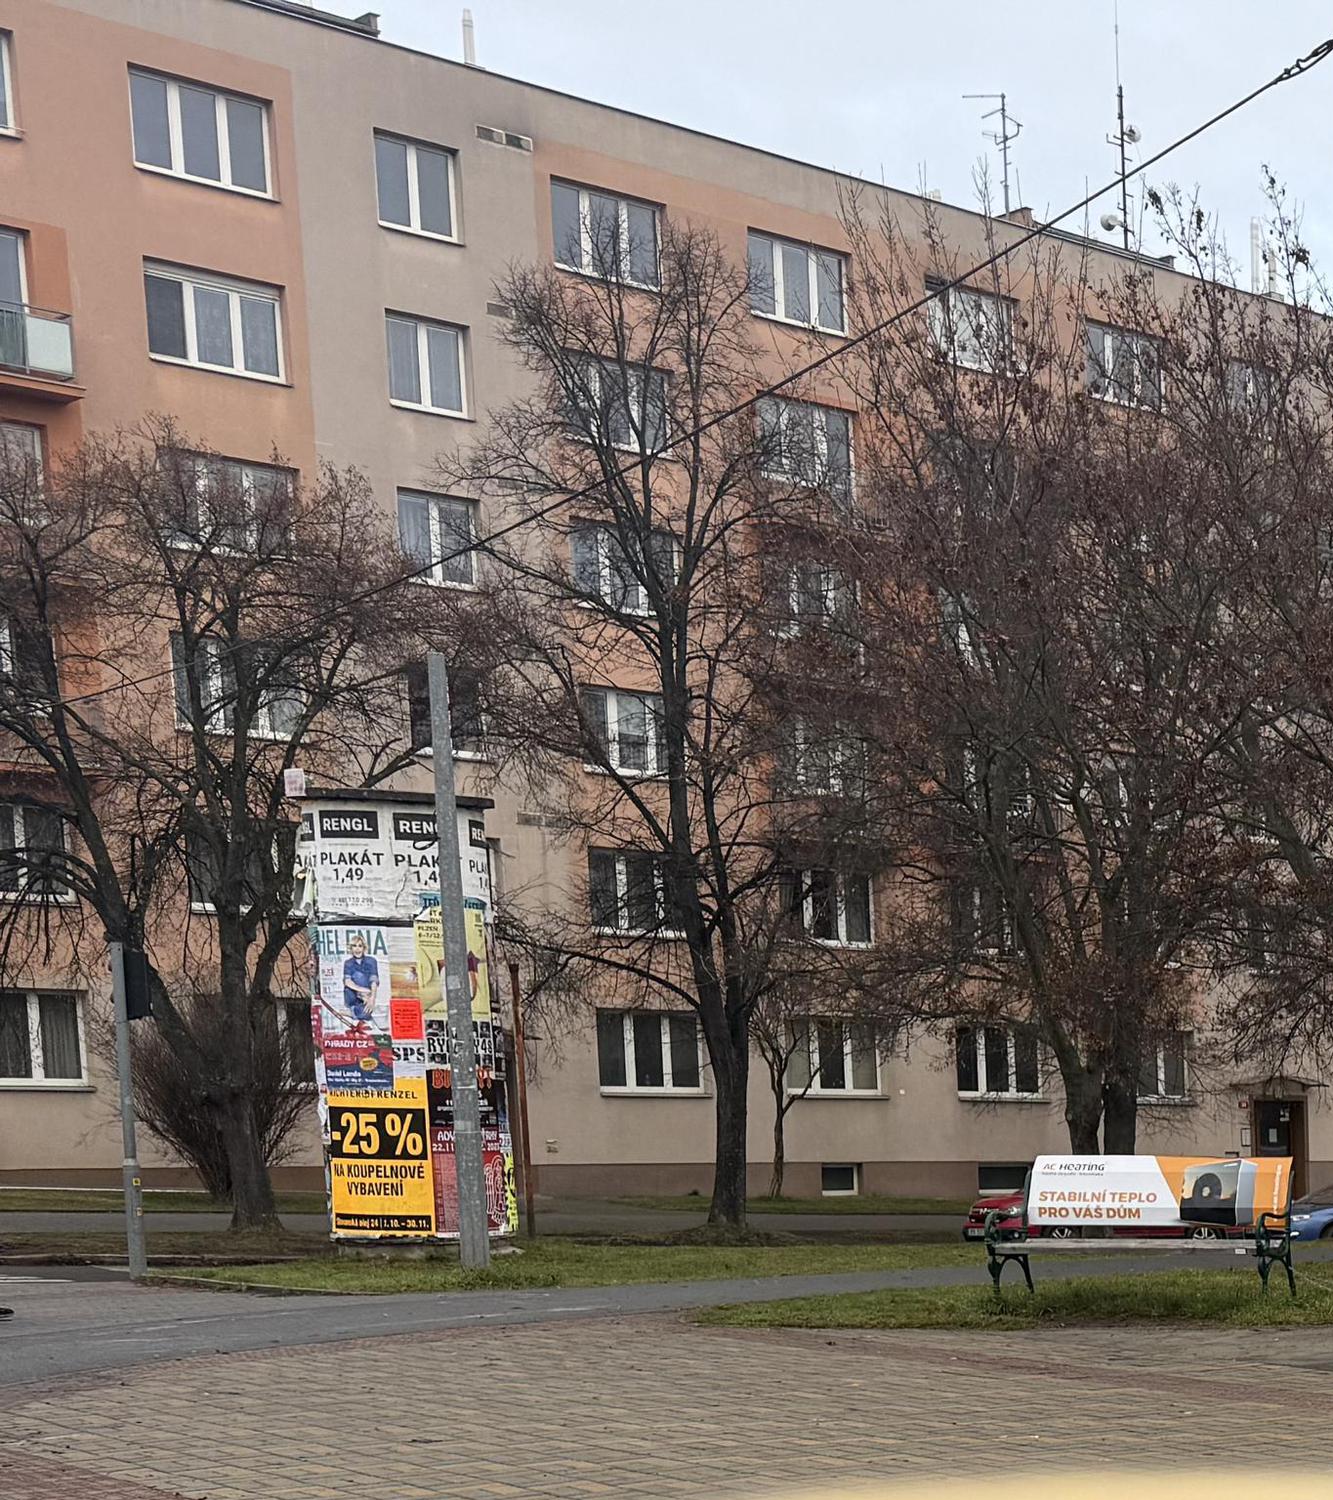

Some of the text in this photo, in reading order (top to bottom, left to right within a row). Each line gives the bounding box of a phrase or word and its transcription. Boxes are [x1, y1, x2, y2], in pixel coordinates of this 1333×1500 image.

[323, 816, 373, 832] RENGL
[399, 820, 438, 835] REN
[320, 849, 384, 866] PLAKÁT
[394, 854, 440, 868] PLAK
[333, 867, 364, 884] 1,49
[413, 870, 440, 886] 1,4
[331, 1112, 423, 1156] -25 %
[334, 1162, 425, 1179] NA KOUPELNOVÉ
[347, 1179, 404, 1196] VYBAVENÍ
[1039, 1189, 1157, 1203] STABILNÍ TEPLO
[1039, 1204, 1141, 1219] PRO VÁŠ DŮM
